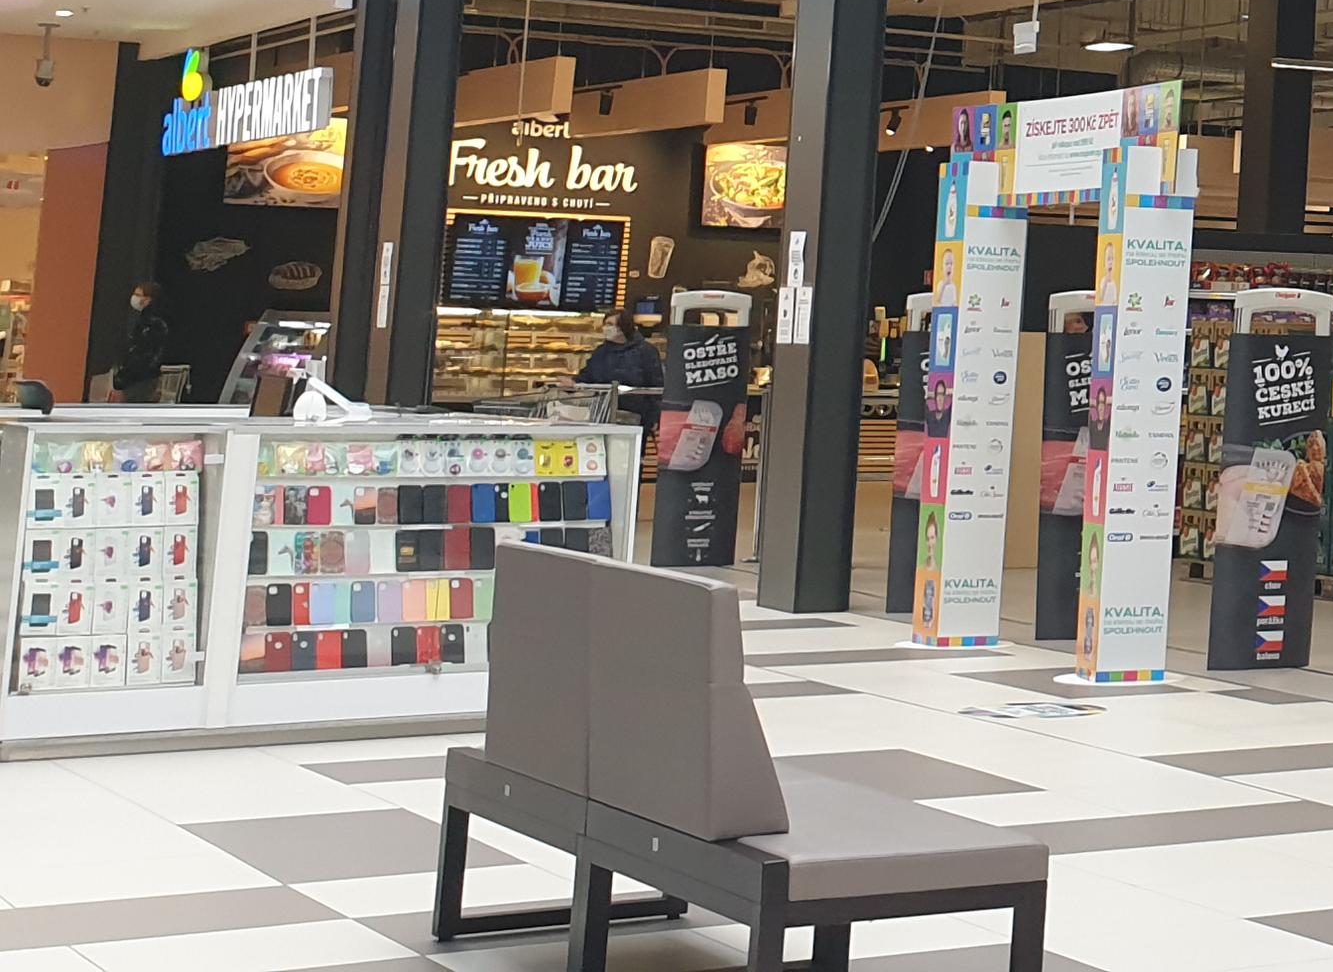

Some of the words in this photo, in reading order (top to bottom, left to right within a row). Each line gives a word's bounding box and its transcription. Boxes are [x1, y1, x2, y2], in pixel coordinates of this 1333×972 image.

[216, 67, 329, 147] HYPERMARKET
[162, 91, 212, 157] albert
[1025, 119, 1067, 137] ZÍSKEJTE
[1069, 117, 1085, 133] 300
[448, 138, 555, 188] Fresh
[566, 145, 638, 193] bar
[480, 193, 548, 207] PŘIPRAVENO
[563, 197, 594, 209] CHUTÍ
[683, 341, 737, 361] OSTŘE
[685, 364, 739, 385] MASO
[1253, 357, 1313, 385] 100%
[1255, 376, 1315, 403] ČESKÉ
[1257, 395, 1316, 420] KUŘECÍ
